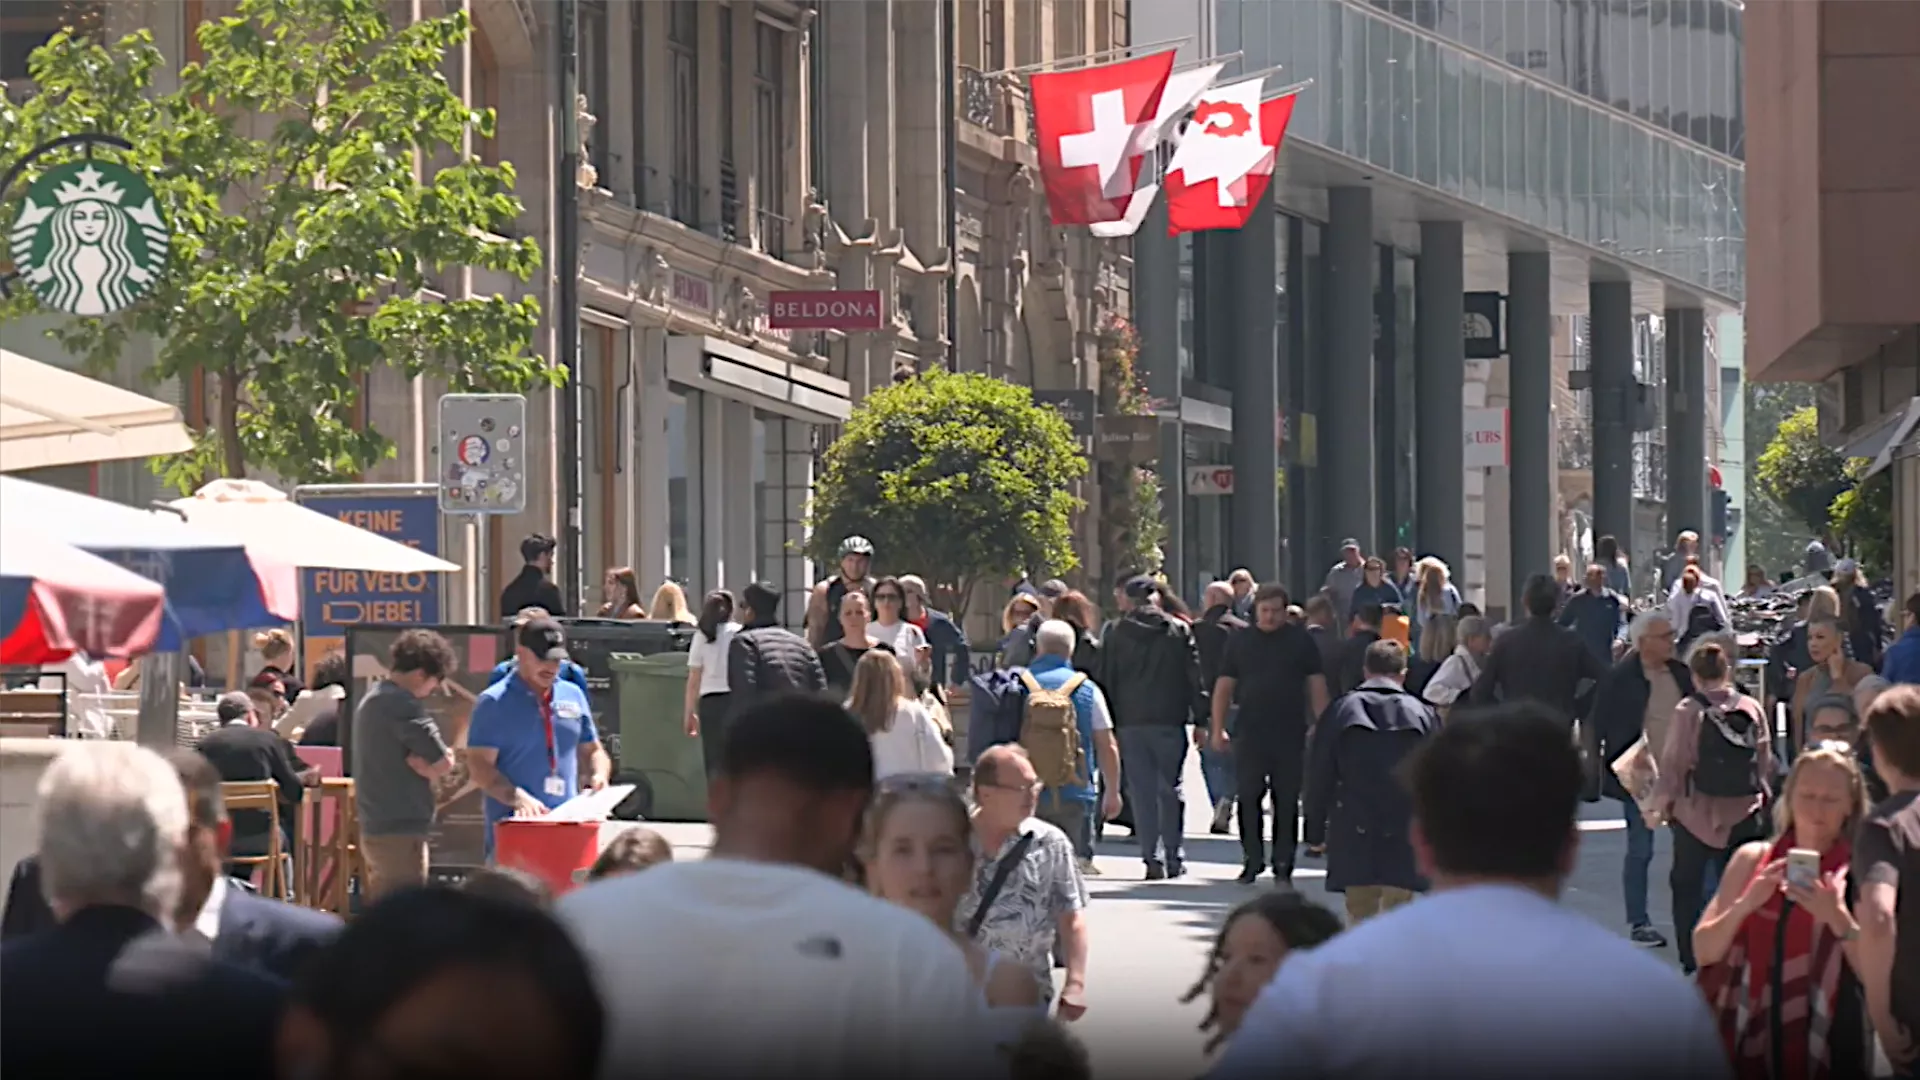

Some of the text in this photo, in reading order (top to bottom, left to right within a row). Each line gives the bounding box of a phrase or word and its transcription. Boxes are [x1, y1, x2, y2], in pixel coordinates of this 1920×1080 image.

[774, 302, 876, 318] BELDONA
[1475, 431, 1502, 444] UBS
[339, 510, 403, 532] KEINE
[362, 570, 428, 593] VELO
